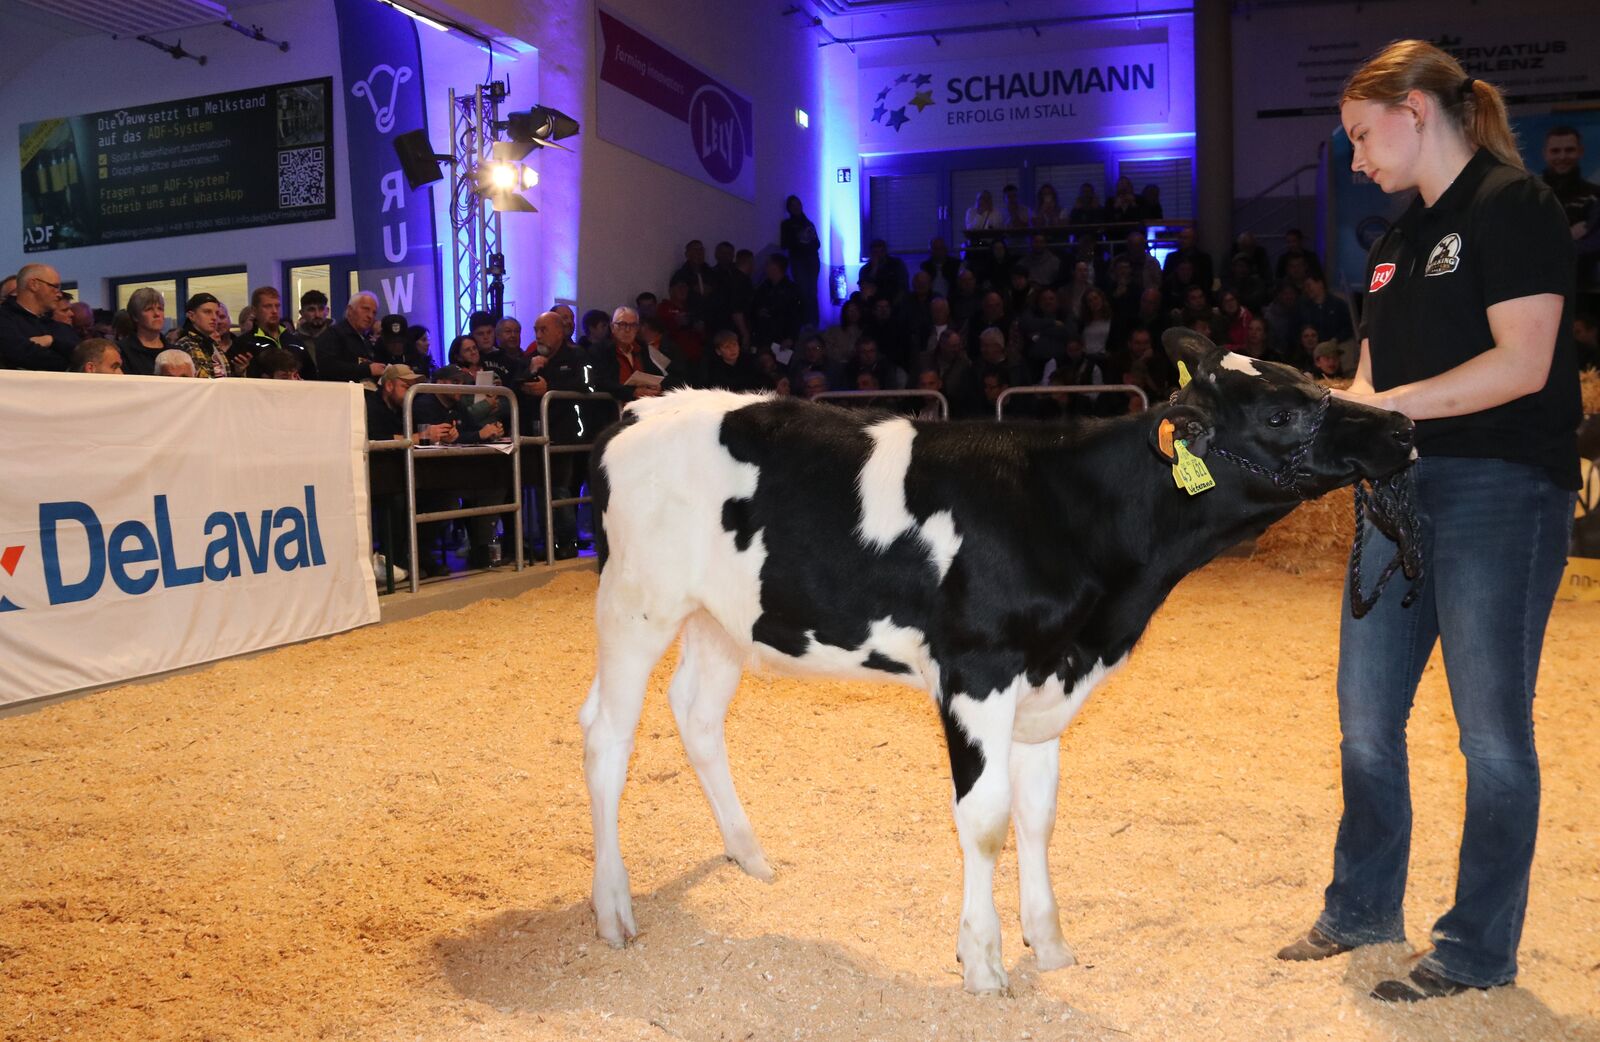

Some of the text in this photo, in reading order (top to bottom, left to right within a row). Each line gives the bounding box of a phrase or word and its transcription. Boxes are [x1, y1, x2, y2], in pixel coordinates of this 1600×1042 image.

[614, 44, 647, 76] farming
[1453, 40, 1567, 59] ERVATIUS
[1466, 57, 1545, 73] HLENZ
[946, 63, 1154, 104] SCHAUMANN
[98, 118, 116, 131] Die
[147, 108, 179, 124] setzt
[186, 104, 199, 118] im
[204, 92, 266, 115] Melkstand
[947, 103, 1076, 125] ERFOLG IM STALL
[98, 120, 213, 147] auf das ADF-System
[100, 186, 136, 201] Fragen
[100, 188, 244, 216] Schreib uns auf WhatsApp
[23, 225, 55, 246] ADF
[39, 485, 326, 606] DeLaval
